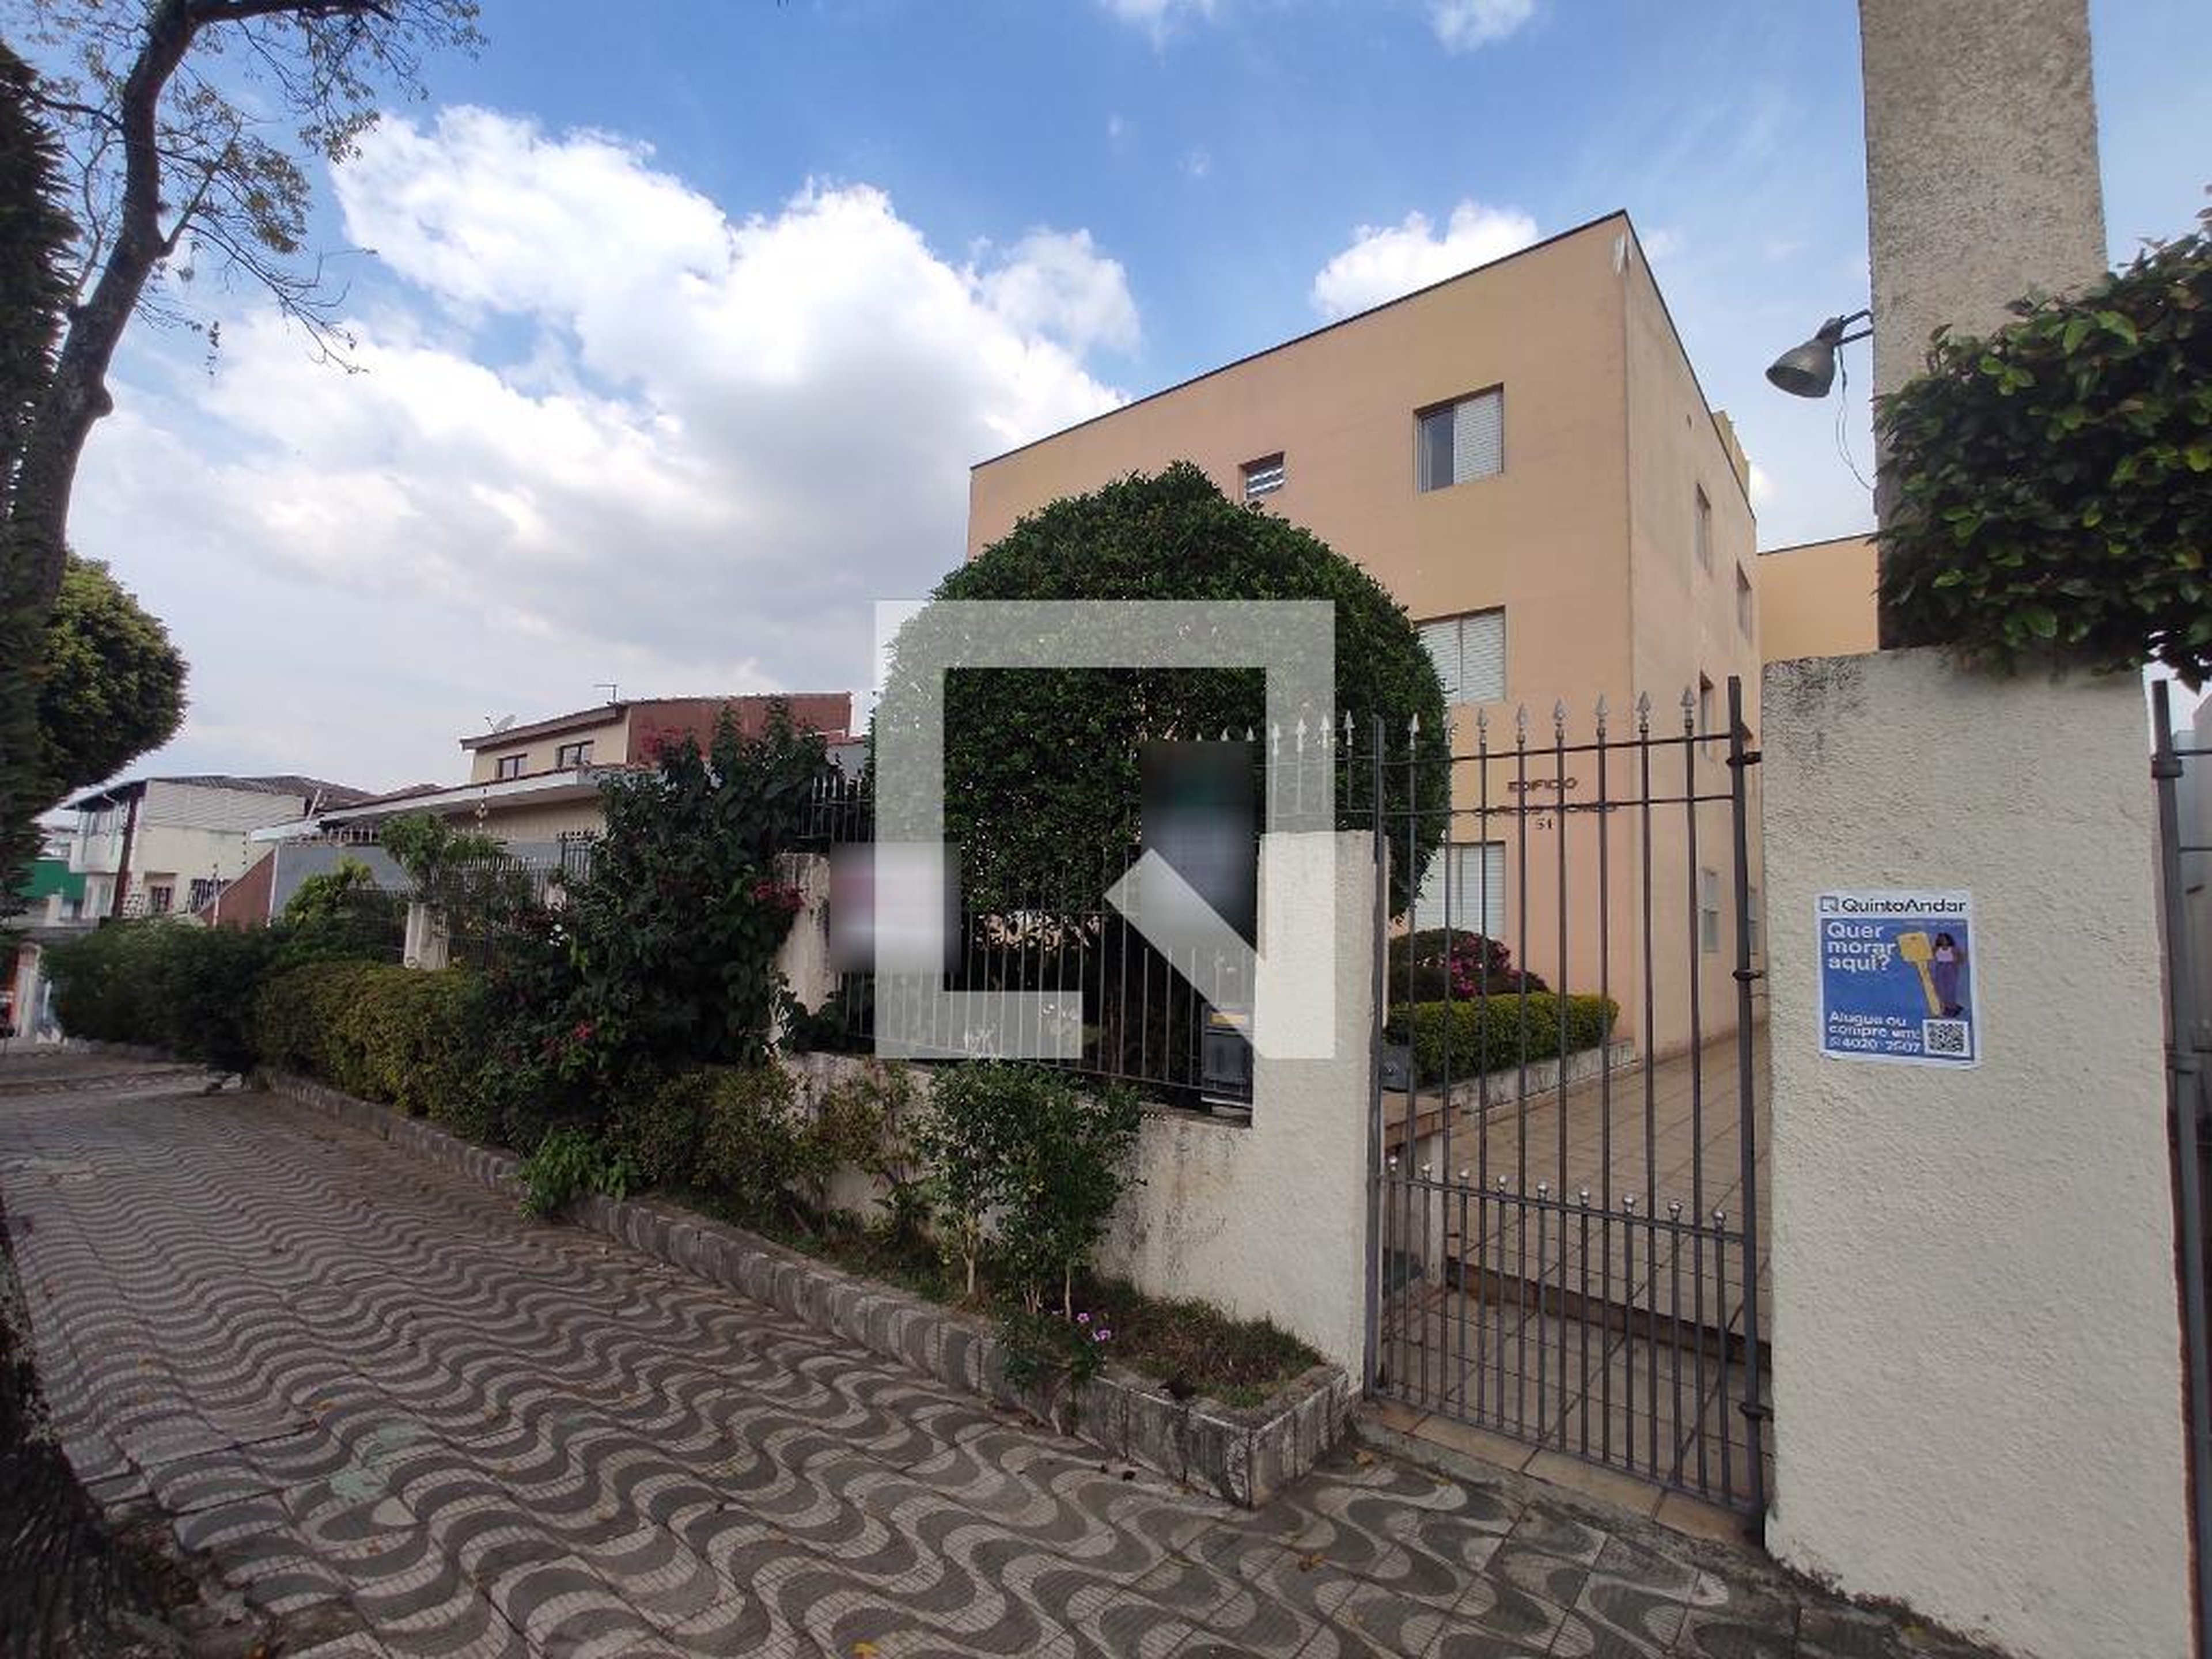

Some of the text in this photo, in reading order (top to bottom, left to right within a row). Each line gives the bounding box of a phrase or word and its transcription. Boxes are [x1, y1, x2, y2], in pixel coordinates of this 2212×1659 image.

[1842, 897, 1966, 912] QuintoAndar
[1827, 922, 1883, 939] Quer
[1827, 940, 1895, 955] morar
[1828, 954, 1891, 974] aqui?
[1829, 1011, 1907, 1027] Alugue ou
[1829, 1025, 1888, 1037] compre
[1842, 1038, 1878, 1051] 4020
